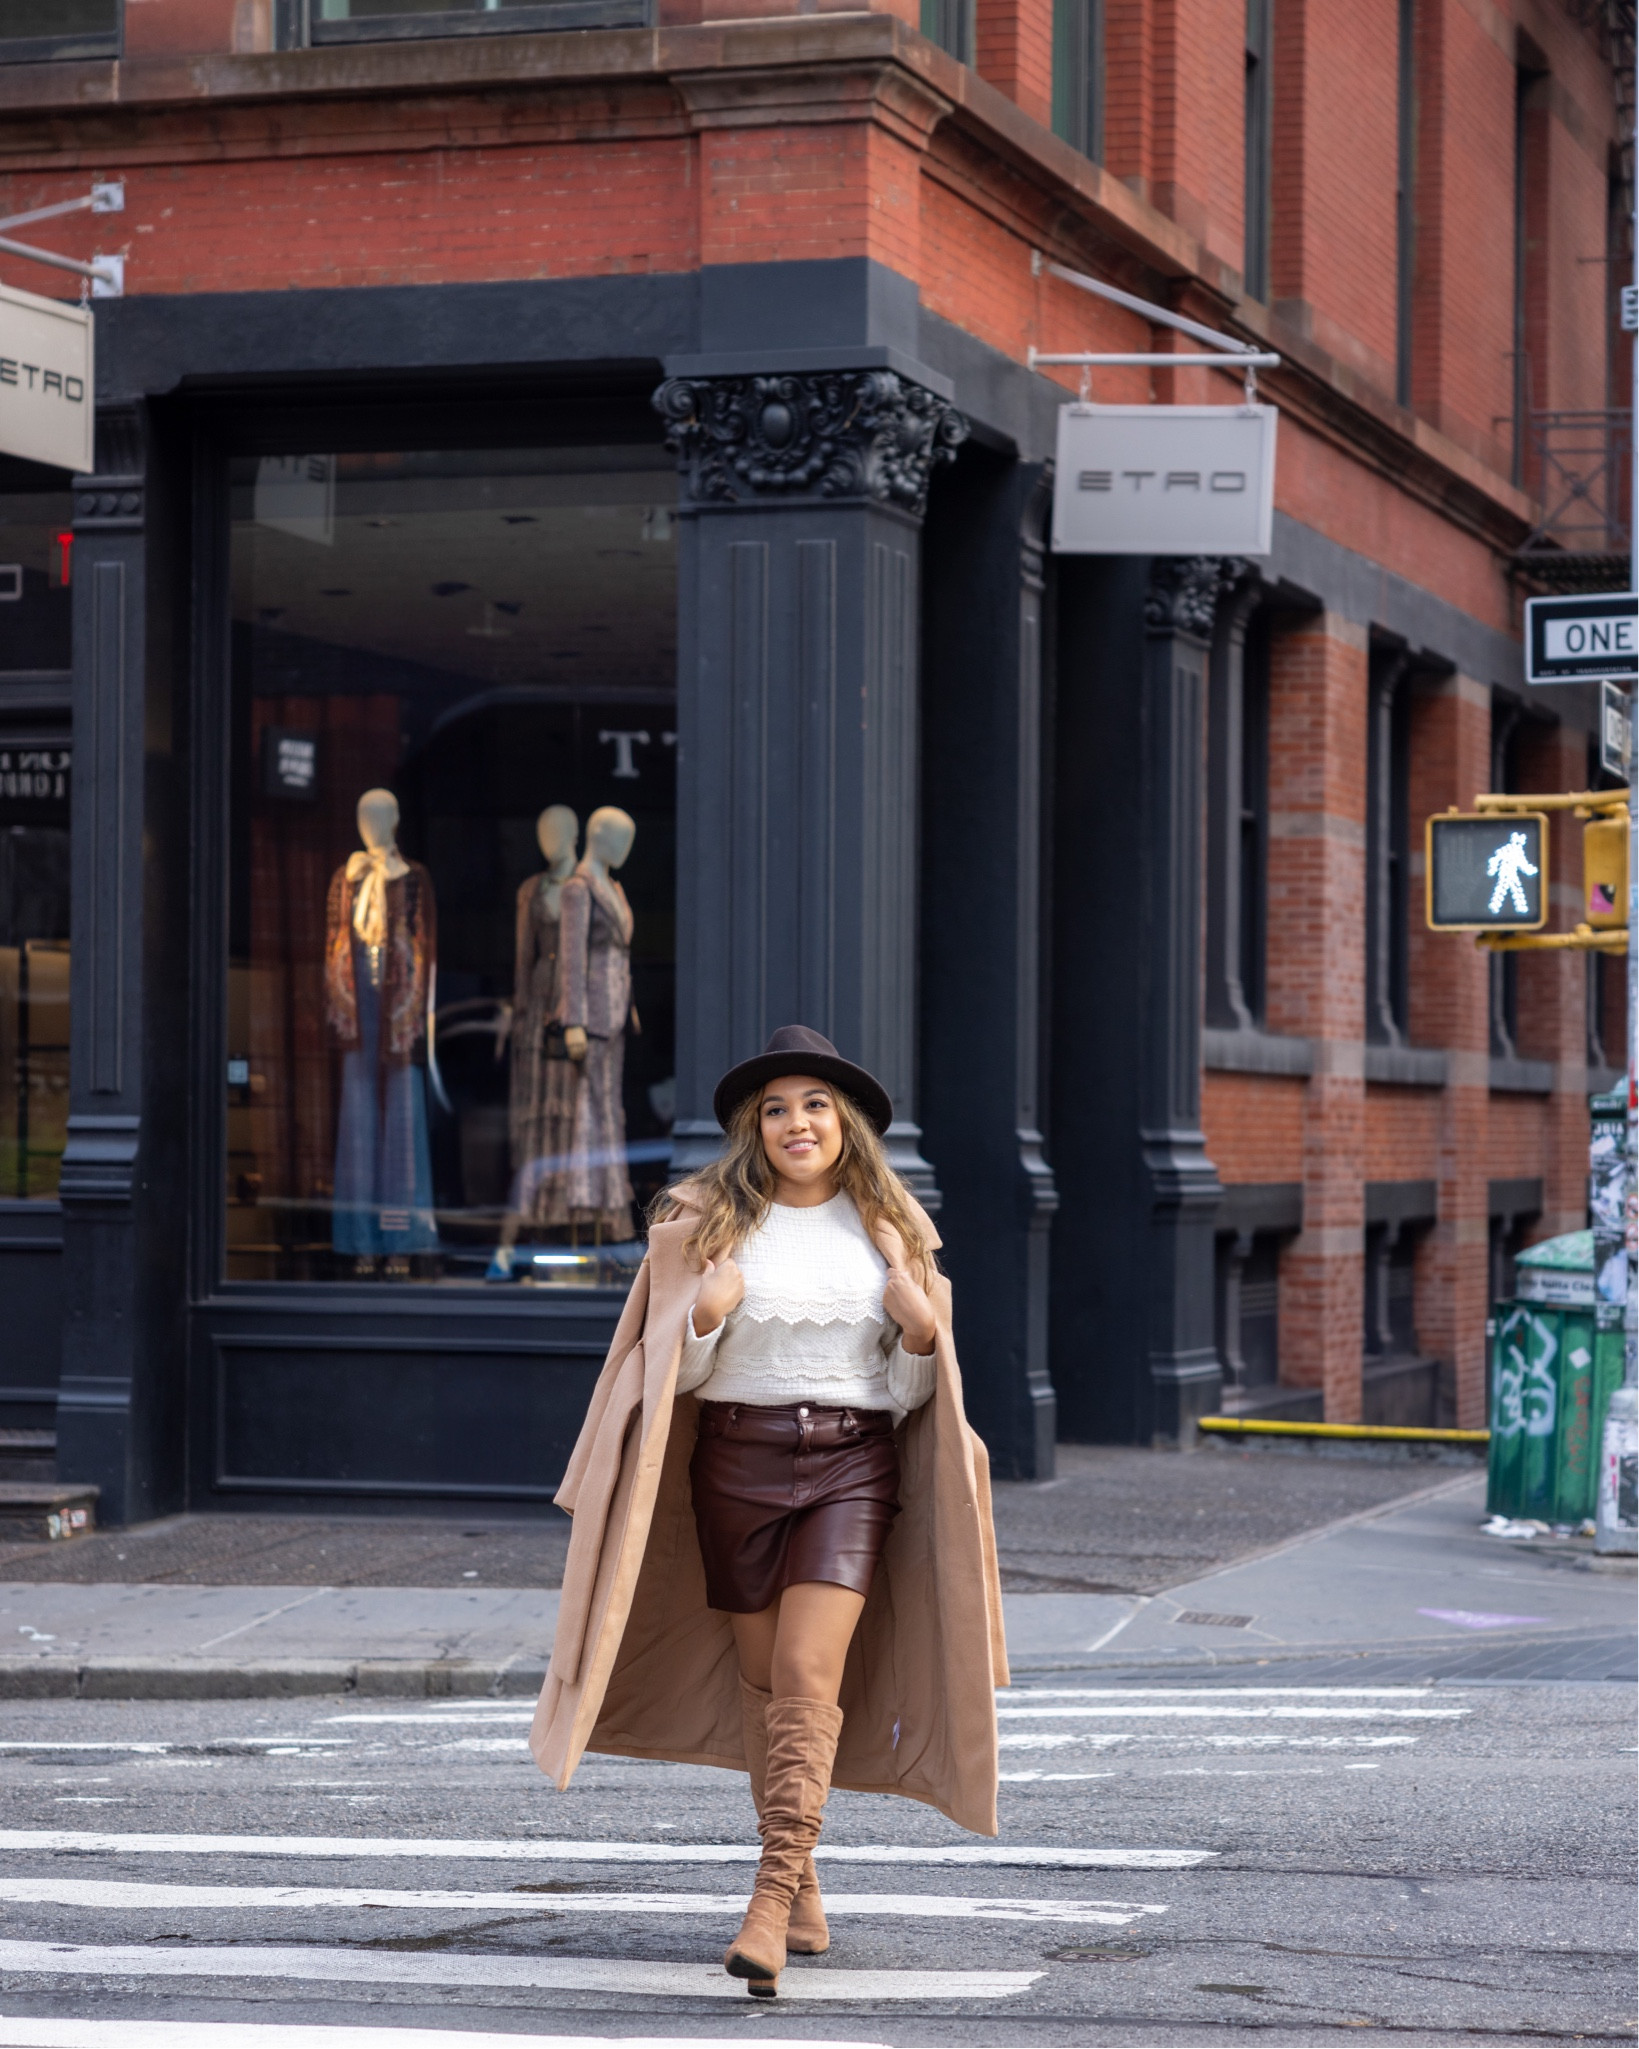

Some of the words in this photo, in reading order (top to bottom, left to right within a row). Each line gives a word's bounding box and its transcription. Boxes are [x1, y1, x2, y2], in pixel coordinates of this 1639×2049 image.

[0, 356, 84, 403] ETRO
[1078, 470, 1246, 493] ETRO
[1565, 621, 1634, 654] ONE
